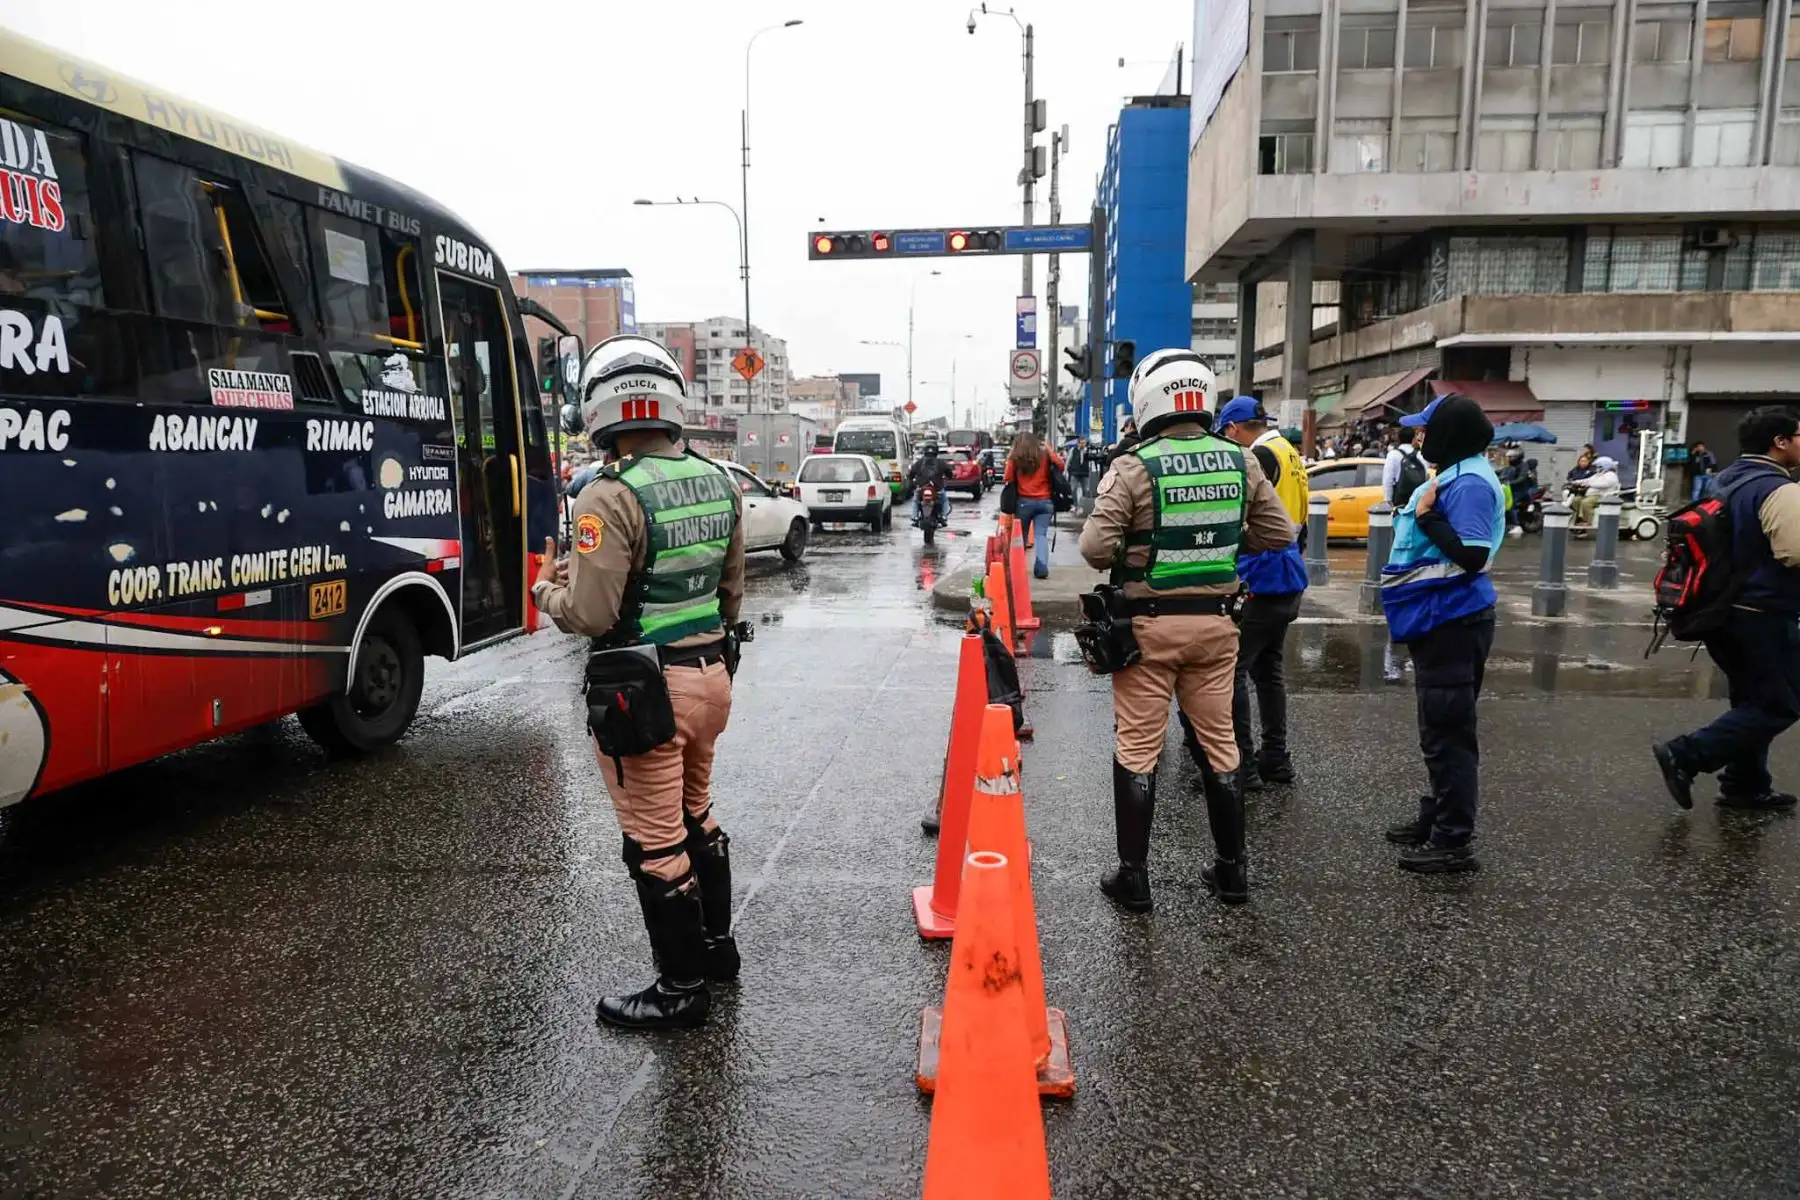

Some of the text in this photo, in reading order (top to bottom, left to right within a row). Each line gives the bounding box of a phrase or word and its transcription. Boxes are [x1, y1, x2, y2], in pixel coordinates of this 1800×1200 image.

[0, 117, 59, 180] DA
[0, 168, 66, 233] UIS
[317, 186, 421, 236] FAMET BUS
[434, 234, 495, 280] SUBIDA
[210, 369, 291, 393] SALAMANCA
[613, 379, 658, 394] POLICIA
[1162, 377, 1208, 395] POLICIA
[213, 389, 294, 411] QUECHUAS
[362, 388, 446, 420] ESTACION ARRIOLA
[149, 414, 259, 452] ABANCAY
[306, 418, 375, 452] RIMAC
[409, 466, 449, 480] HYUNDAI
[1160, 451, 1237, 475] POLICIA
[384, 488, 452, 520] GAMARRA
[653, 475, 727, 510] POLICIA
[1165, 484, 1239, 503] TRANSITO
[664, 511, 731, 549] TRANSITO
[107, 564, 162, 606] COOP.
[166, 556, 226, 597] TRANS.
[230, 548, 288, 587] COMITE
[289, 544, 322, 578] CIEN
[314, 584, 343, 614] 2412
